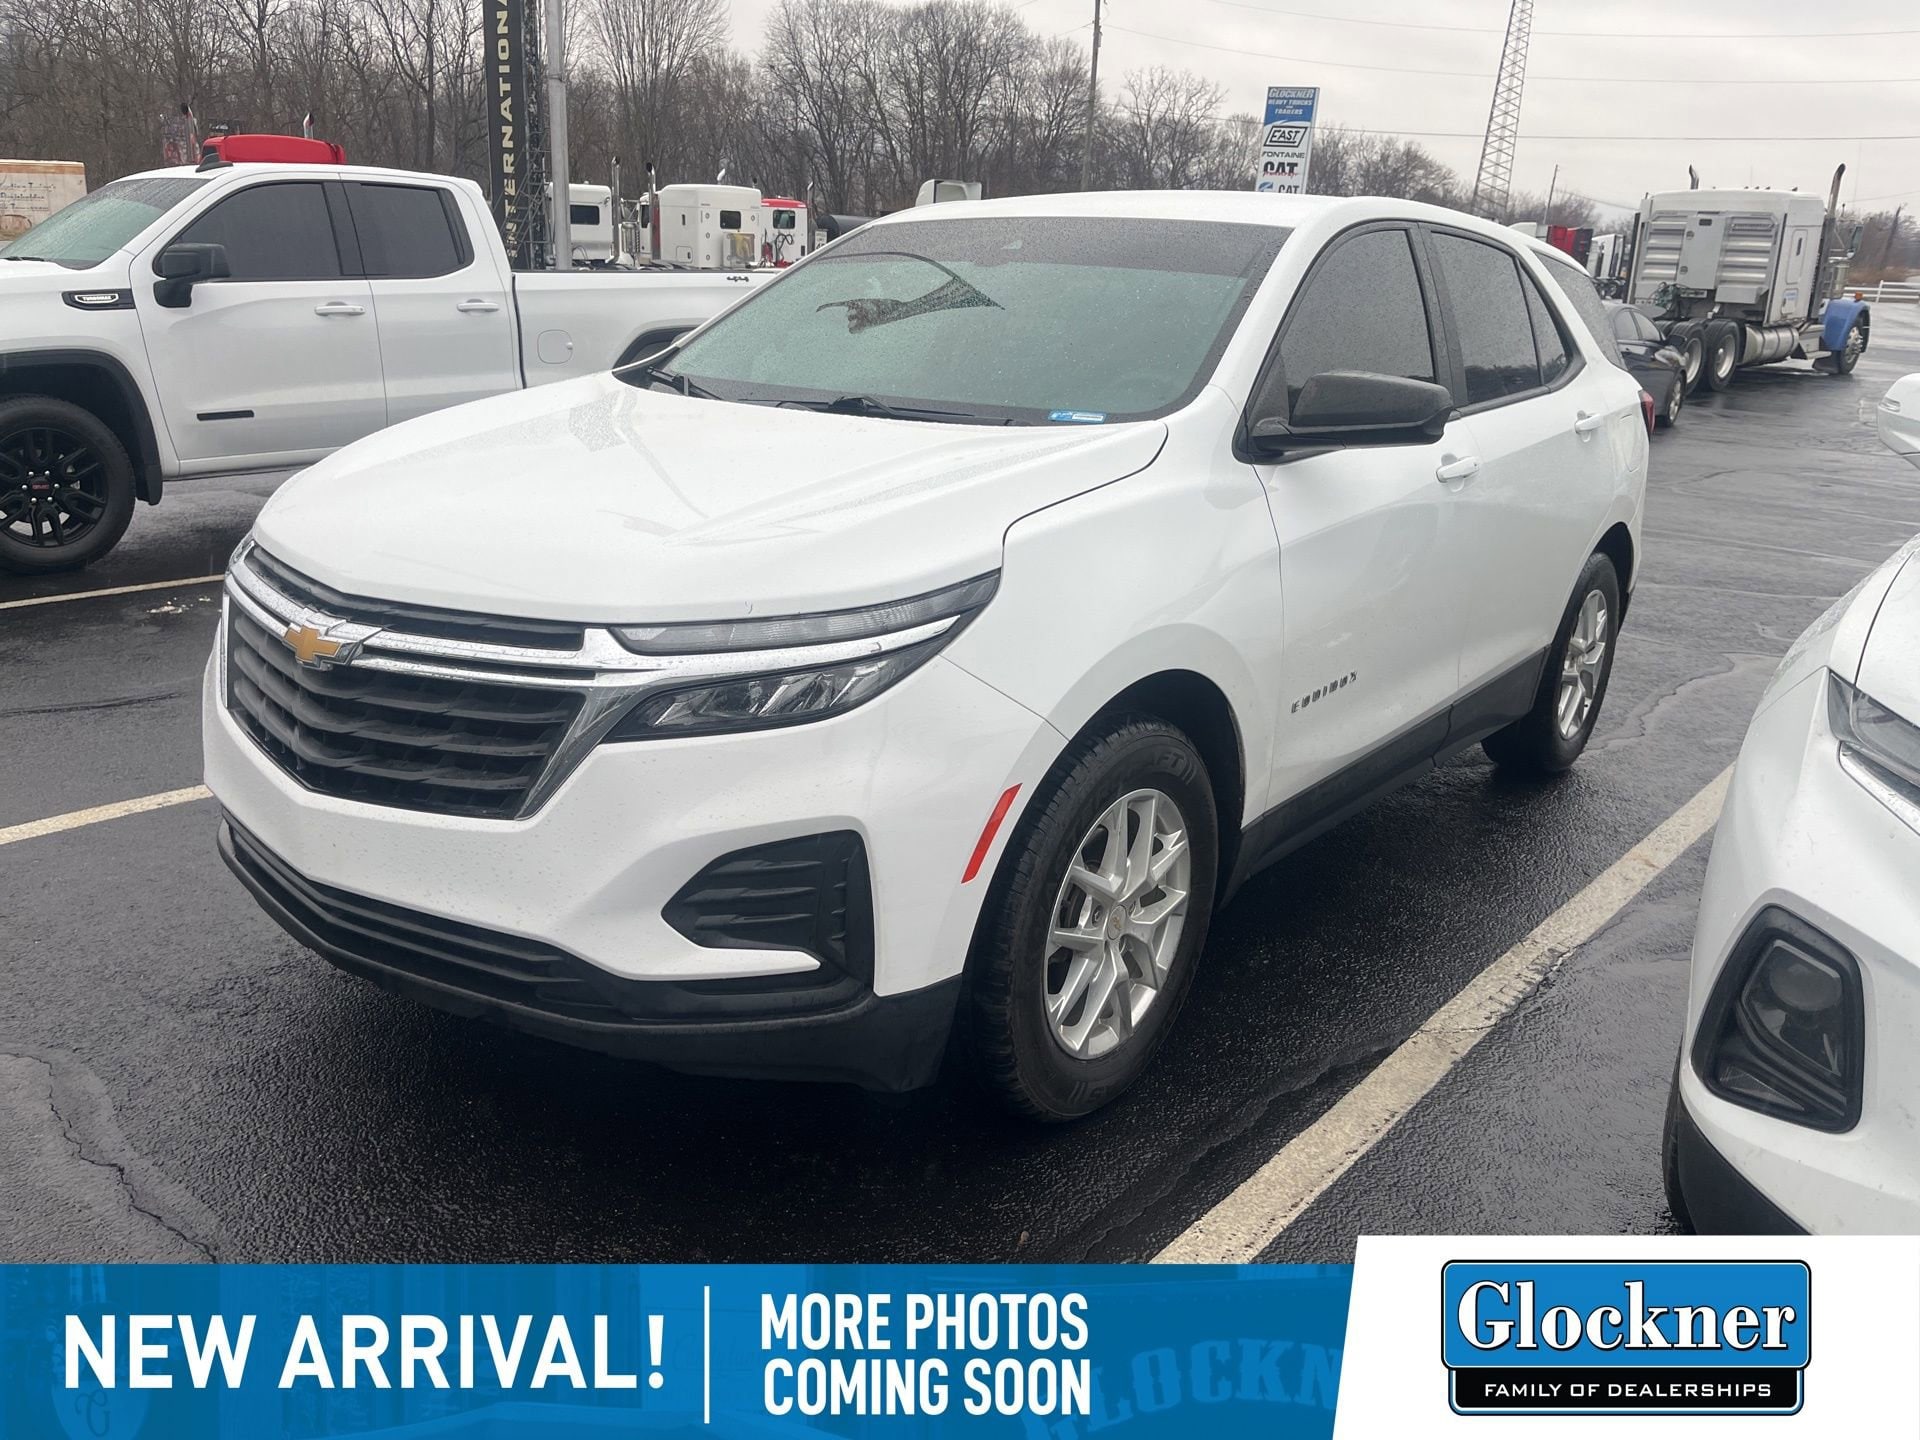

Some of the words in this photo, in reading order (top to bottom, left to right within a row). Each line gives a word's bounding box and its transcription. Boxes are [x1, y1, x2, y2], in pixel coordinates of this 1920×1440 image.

[1268, 88, 1315, 99] GLOCKNER
[1270, 129, 1300, 143] EAST
[1263, 161, 1299, 174] CAT
[1278, 184, 1300, 194] CAT
[1291, 670, 1358, 714] EQUINOX
